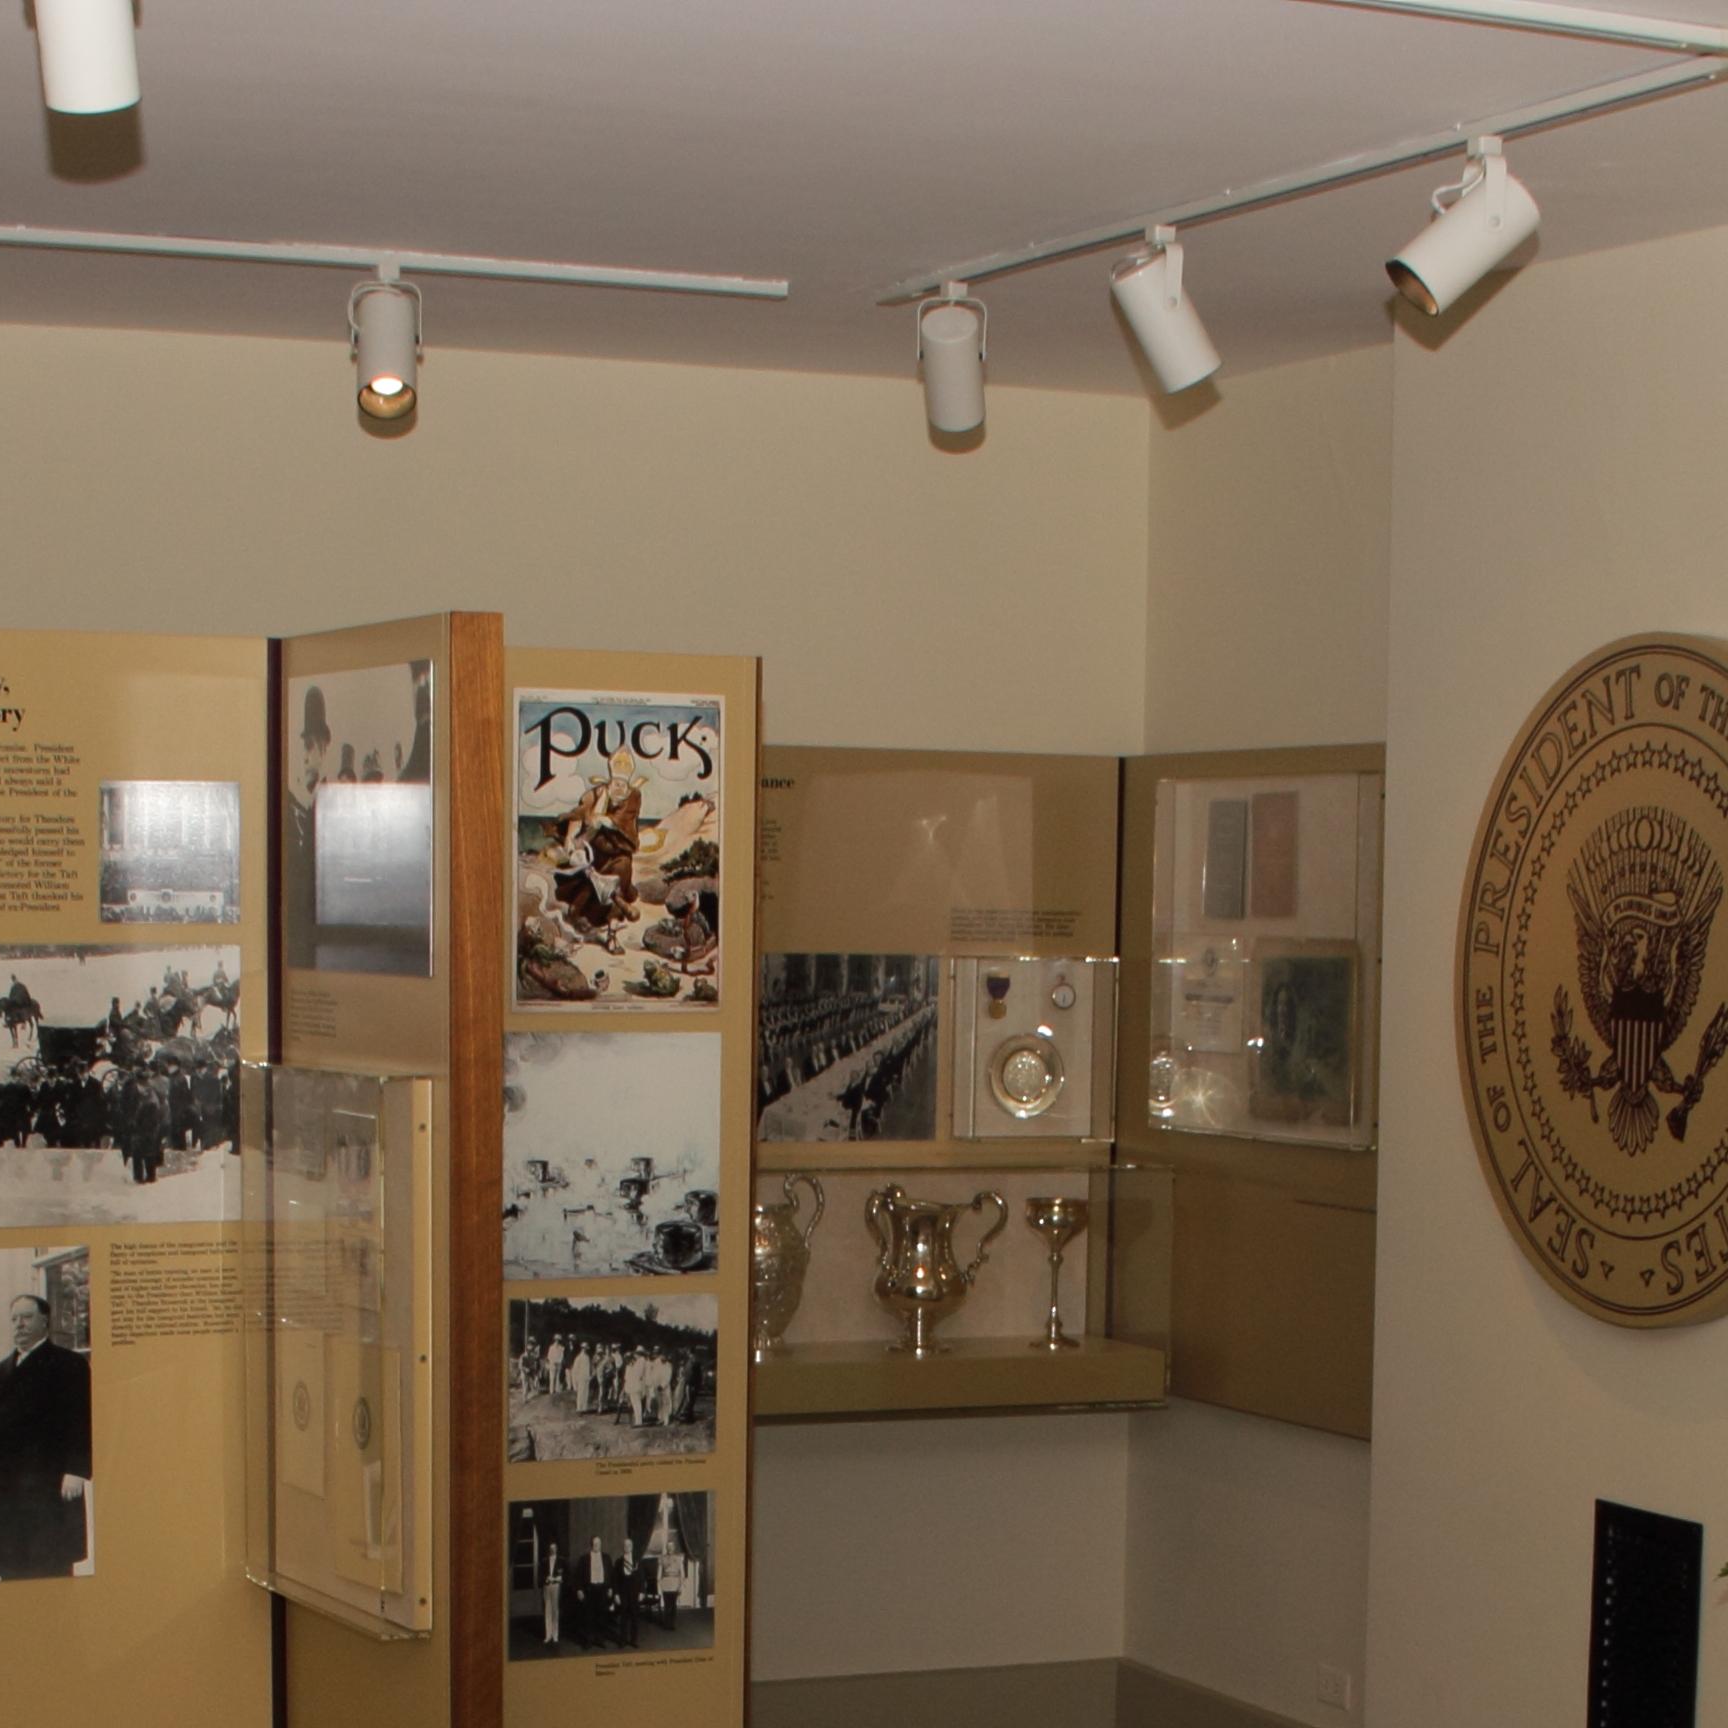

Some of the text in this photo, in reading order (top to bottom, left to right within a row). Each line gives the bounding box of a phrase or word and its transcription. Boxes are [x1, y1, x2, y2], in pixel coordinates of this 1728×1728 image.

[1654, 672, 1689, 711] OF
[1473, 664, 1642, 958] PRESIDENT
[1475, 985, 1498, 1064] THE
[1486, 1084, 1512, 1132] OF
[1510, 1137, 1596, 1279] SEAL
